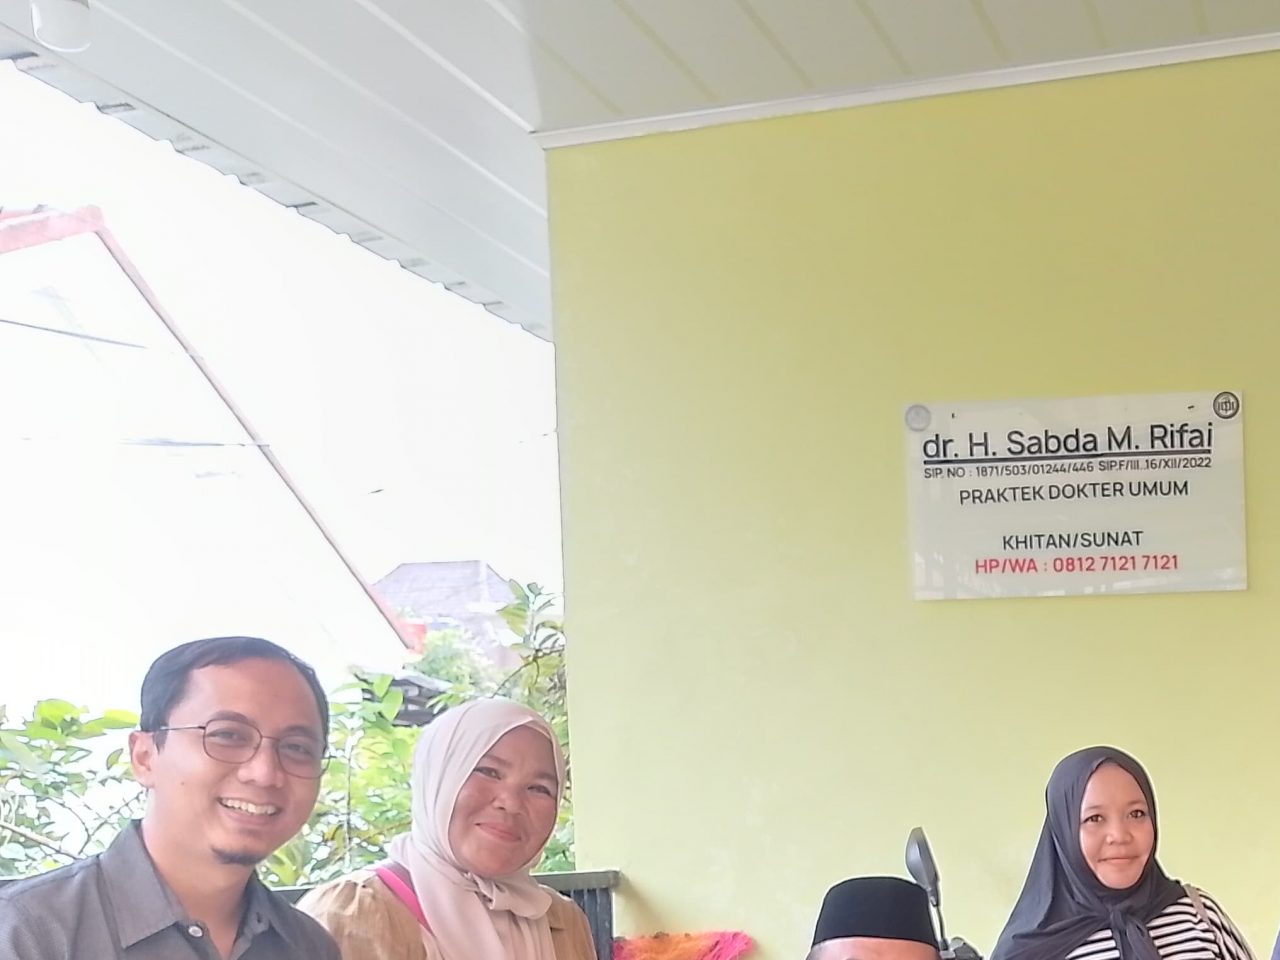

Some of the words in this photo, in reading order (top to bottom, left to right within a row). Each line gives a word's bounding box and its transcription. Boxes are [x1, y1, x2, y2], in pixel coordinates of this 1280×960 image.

[923, 433, 959, 459] dr.
[969, 432, 997, 457] H.
[1007, 428, 1098, 455] Sabda
[1107, 425, 1140, 451] M.
[1150, 422, 1213, 449] Rifai
[976, 461, 1094, 477] 1871/503/01244/446
[959, 485, 1044, 505] PRAKTEK
[1048, 482, 1124, 500] DOKTER
[1128, 480, 1189, 497] UMUM
[1003, 531, 1144, 550] KHITAN/SUNAT
[975, 557, 1038, 574] HP/WA
[1053, 556, 1096, 573] 0812
[1100, 555, 1137, 571] 7121
[1141, 554, 1179, 570] 7121
